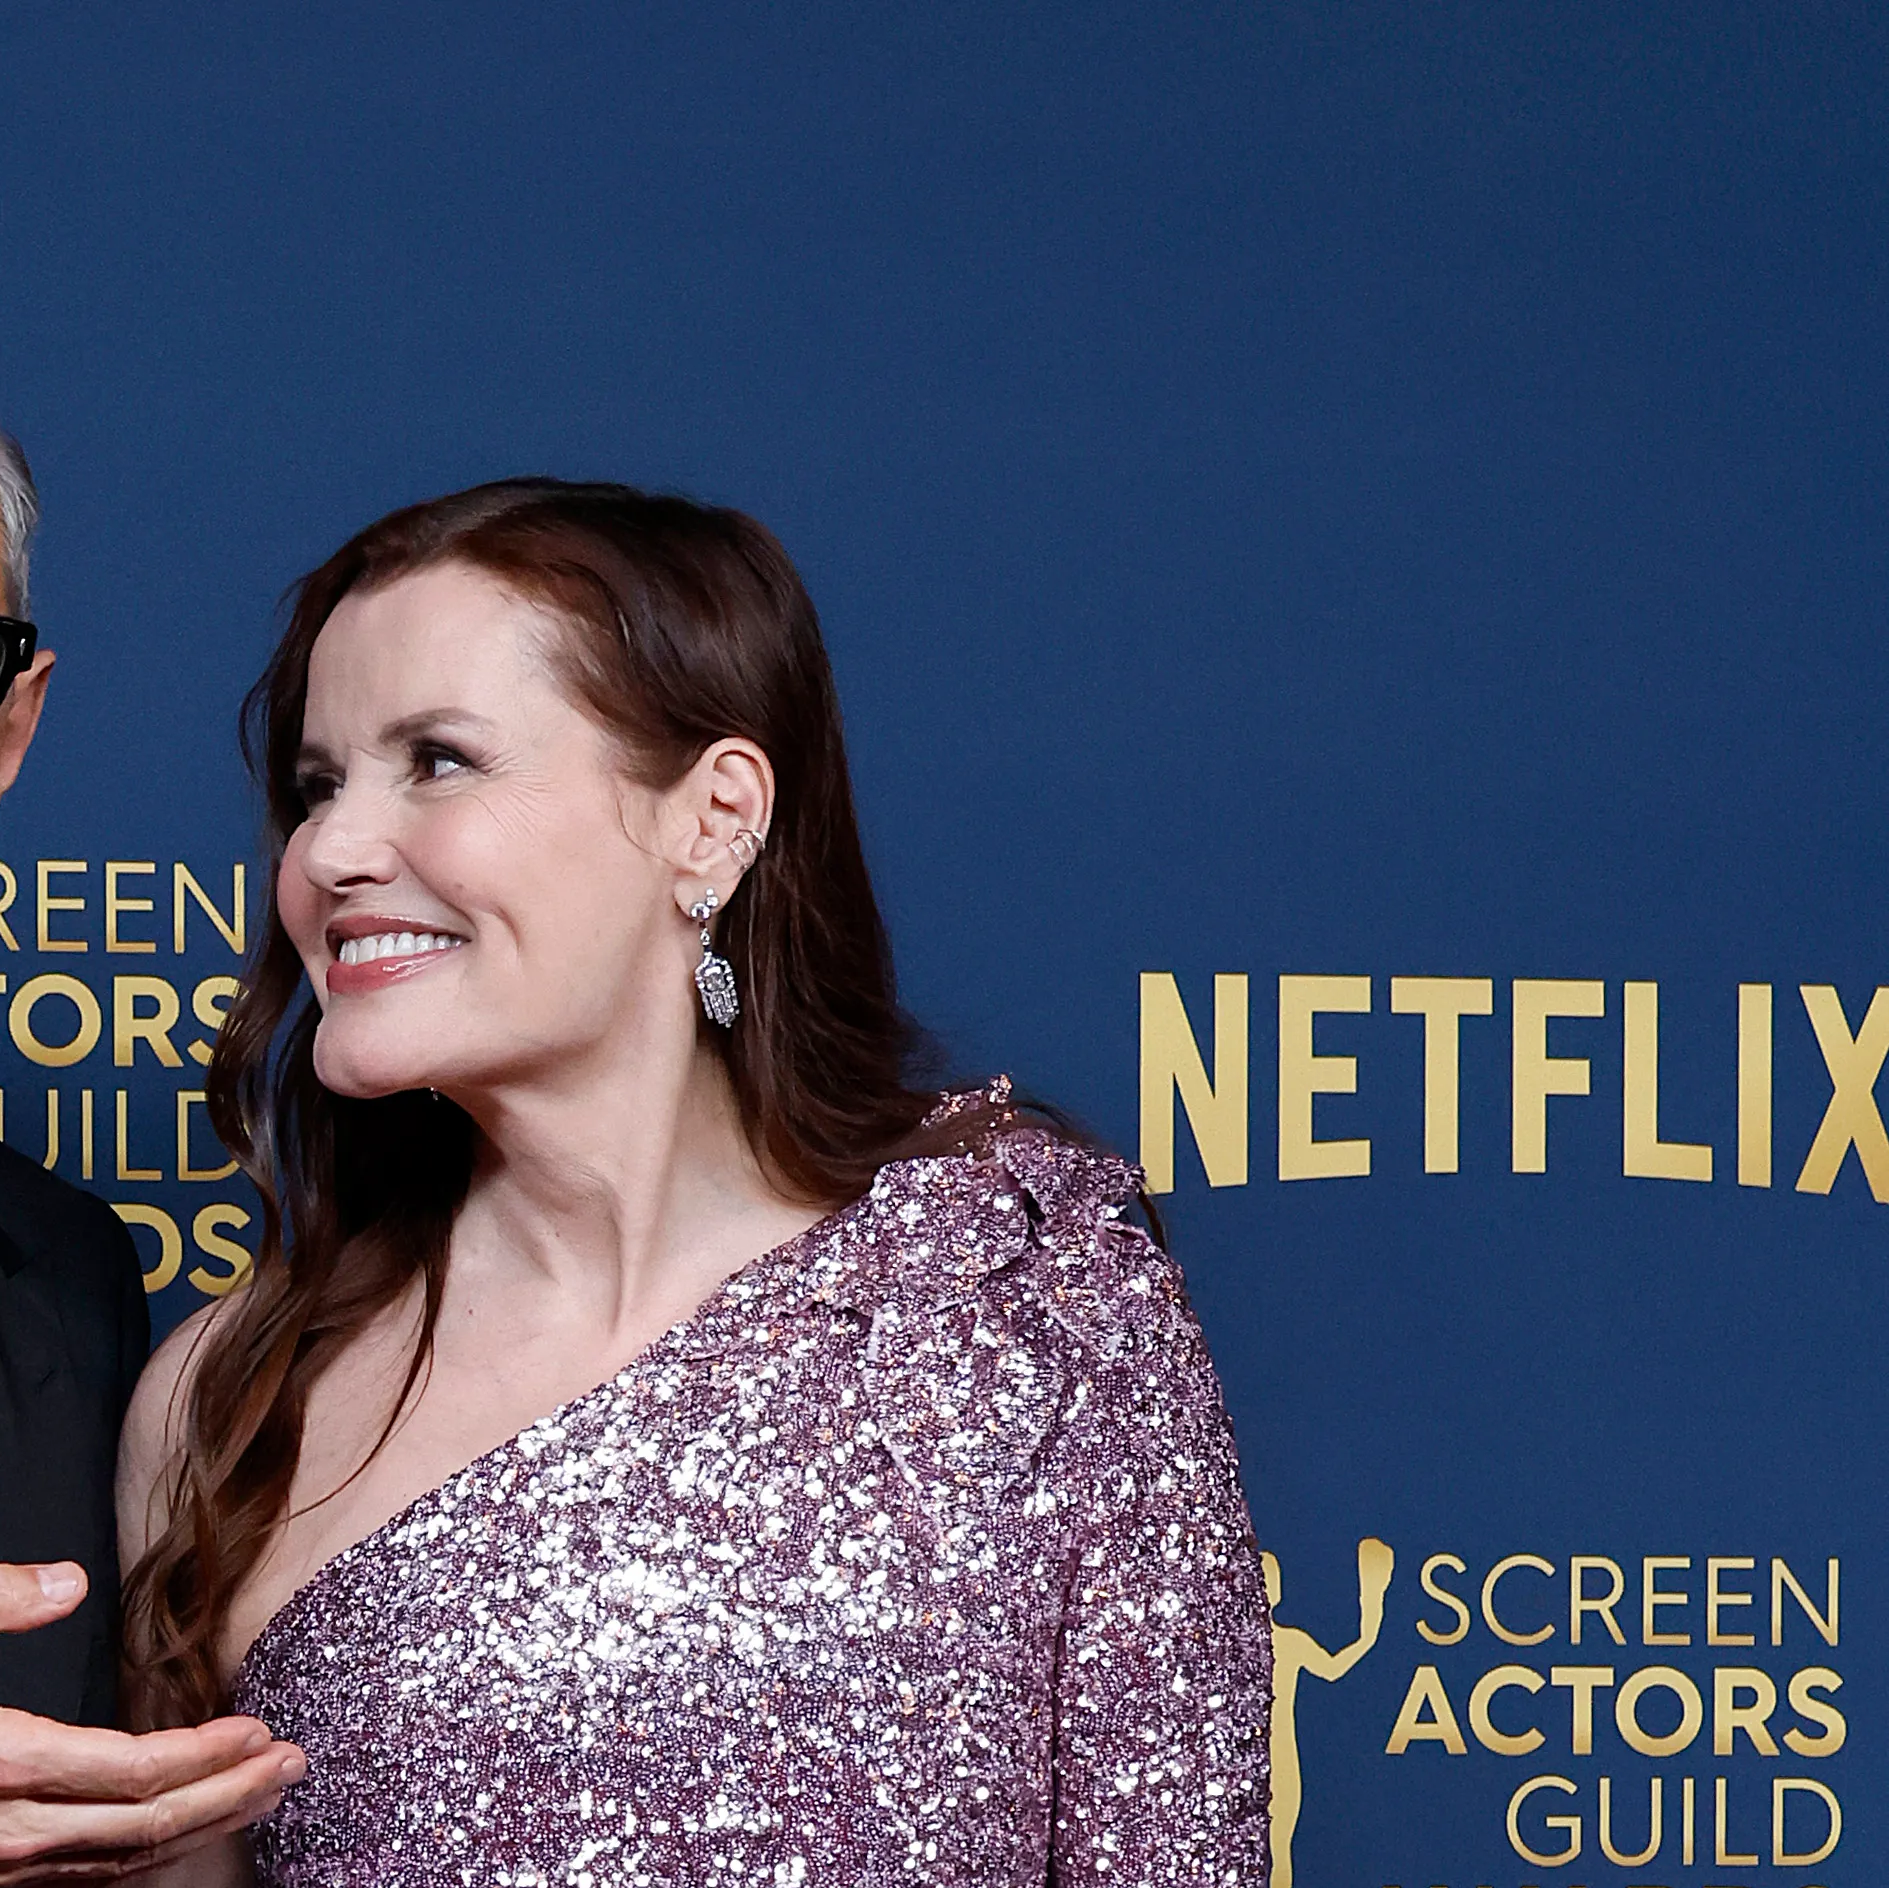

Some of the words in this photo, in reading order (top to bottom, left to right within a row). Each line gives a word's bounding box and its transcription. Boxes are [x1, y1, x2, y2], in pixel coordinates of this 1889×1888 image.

[1139, 972, 1889, 1204] NETFLIX
[1415, 1553, 1840, 1647] SCREEN
[1385, 1664, 1848, 1757] ACTORS
[1506, 1774, 1843, 1867] GUILD
